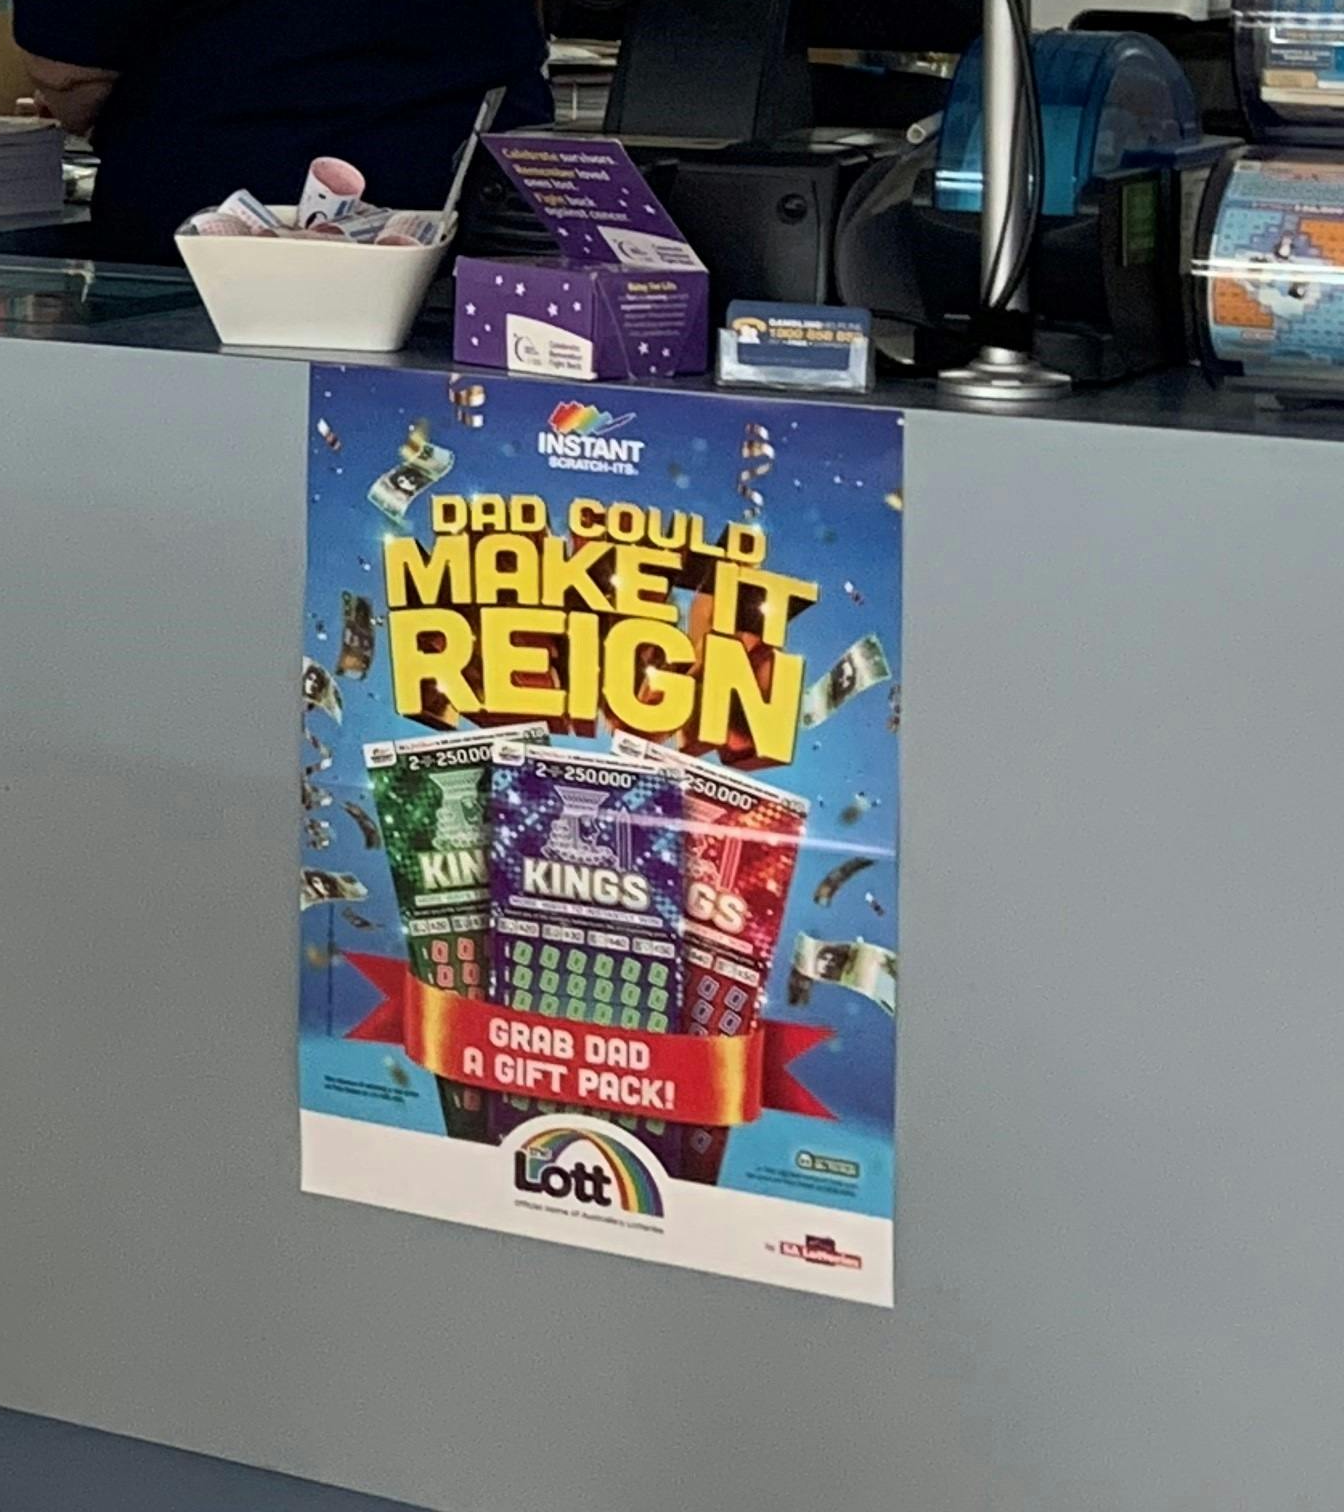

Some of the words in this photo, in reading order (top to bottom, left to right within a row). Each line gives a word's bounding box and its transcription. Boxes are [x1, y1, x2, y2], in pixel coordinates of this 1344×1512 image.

[538, 431, 645, 463] INSTANT
[431, 493, 549, 534] DAD
[568, 497, 768, 565] COULD
[383, 532, 682, 623] MAKE
[712, 560, 819, 648] IT
[388, 606, 806, 764] REIGN
[523, 856, 651, 912] KINGS
[686, 881, 749, 935] GS
[488, 1017, 575, 1060] GRAB
[585, 1030, 651, 1072] DAD
[461, 1047, 485, 1077] A
[493, 1055, 569, 1100] GIFT
[577, 1068, 675, 1110] PACK!
[514, 1150, 612, 1207] Lott
